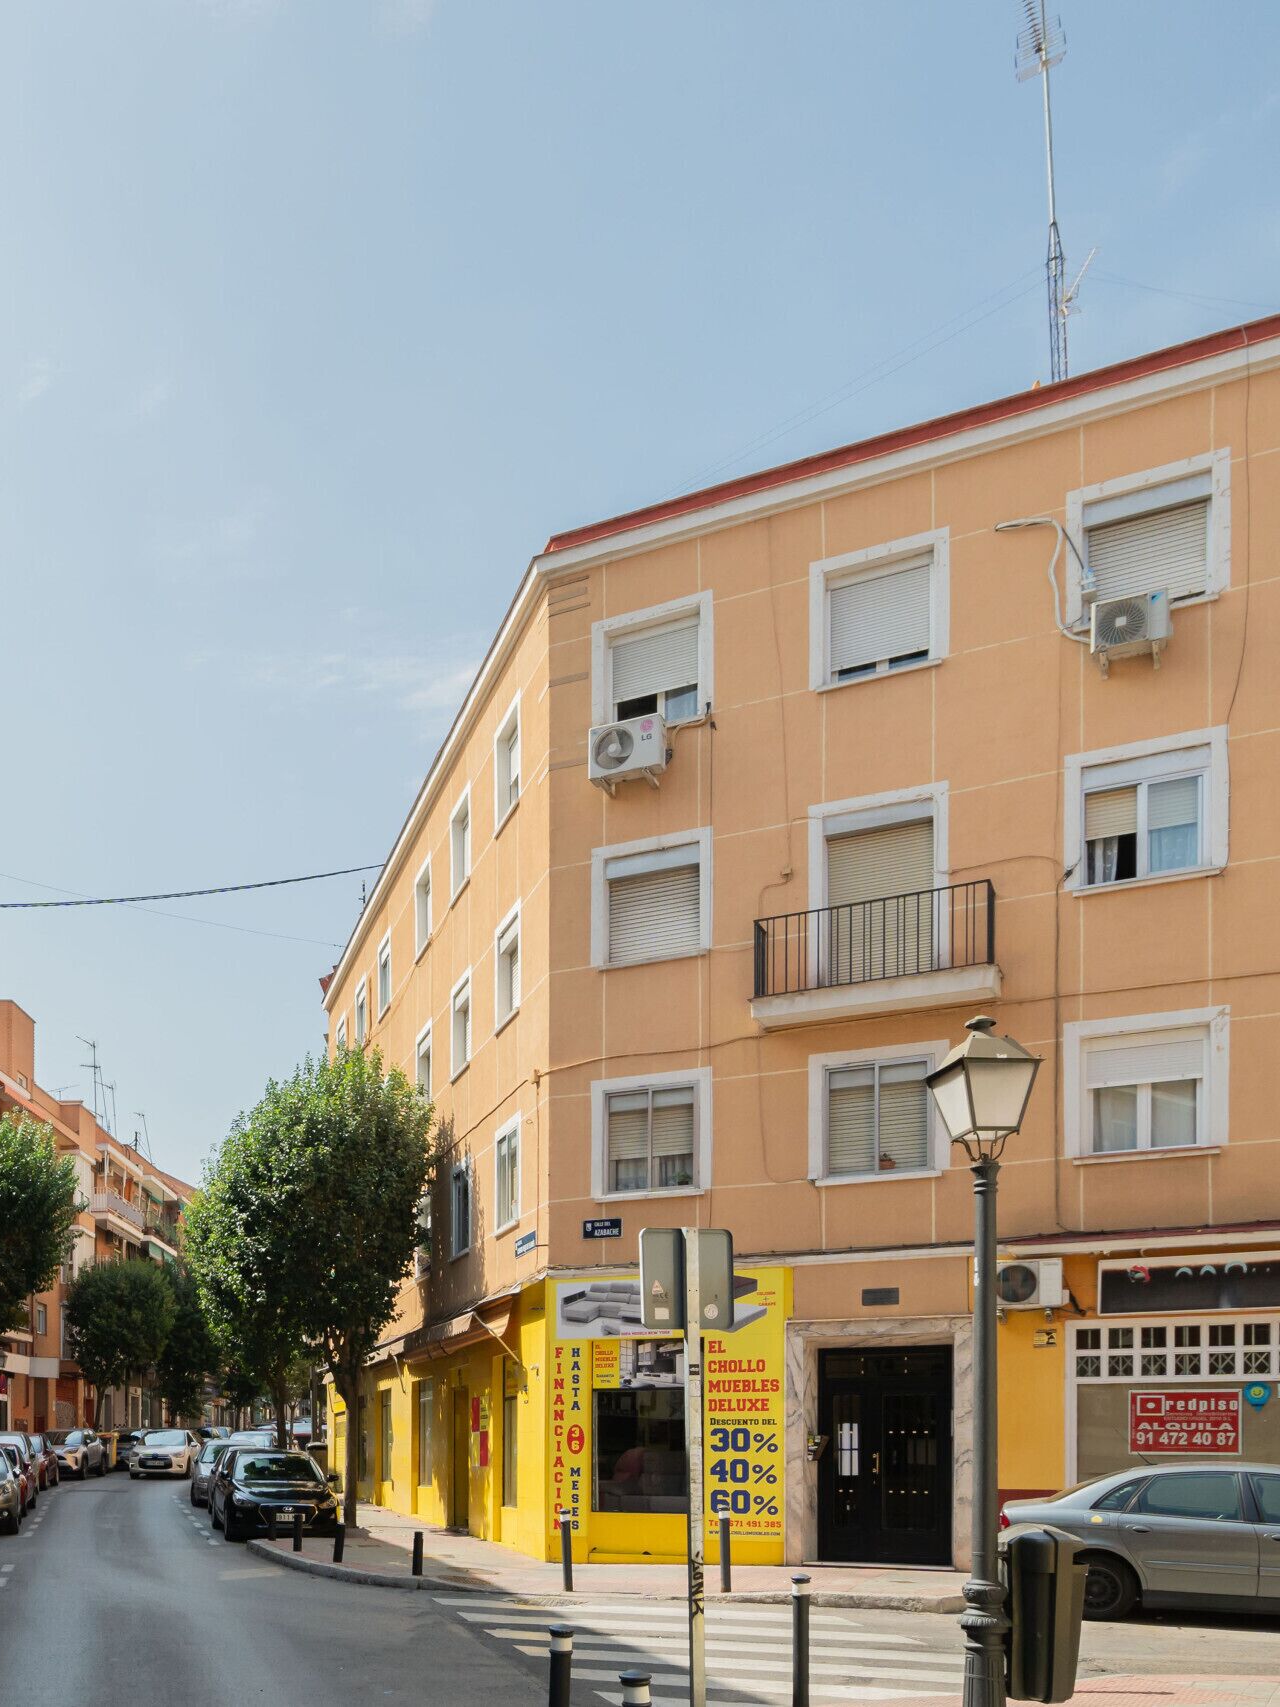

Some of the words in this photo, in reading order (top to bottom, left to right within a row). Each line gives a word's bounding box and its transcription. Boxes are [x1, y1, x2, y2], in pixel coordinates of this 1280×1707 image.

[594, 1228, 619, 1237] AZABACHE
[708, 1340, 726, 1354] EL
[708, 1359, 766, 1374] CHOLLO
[570, 1347, 582, 1411] HASTA
[708, 1379, 780, 1393] MUEBLES
[708, 1398, 769, 1412] DELUXE
[1165, 1398, 1238, 1412] redpiso
[1137, 1422, 1234, 1431] ALQUILA
[710, 1427, 778, 1453] 30%
[1136, 1432, 1154, 1445] 91
[1159, 1432, 1188, 1445] 472
[1192, 1433, 1212, 1445] 40
[1216, 1433, 1236, 1446] 87
[710, 1458, 777, 1484] 40%
[570, 1467, 582, 1531] MESES
[710, 1489, 778, 1515] 60%
[764, 1521, 782, 1529] 385
